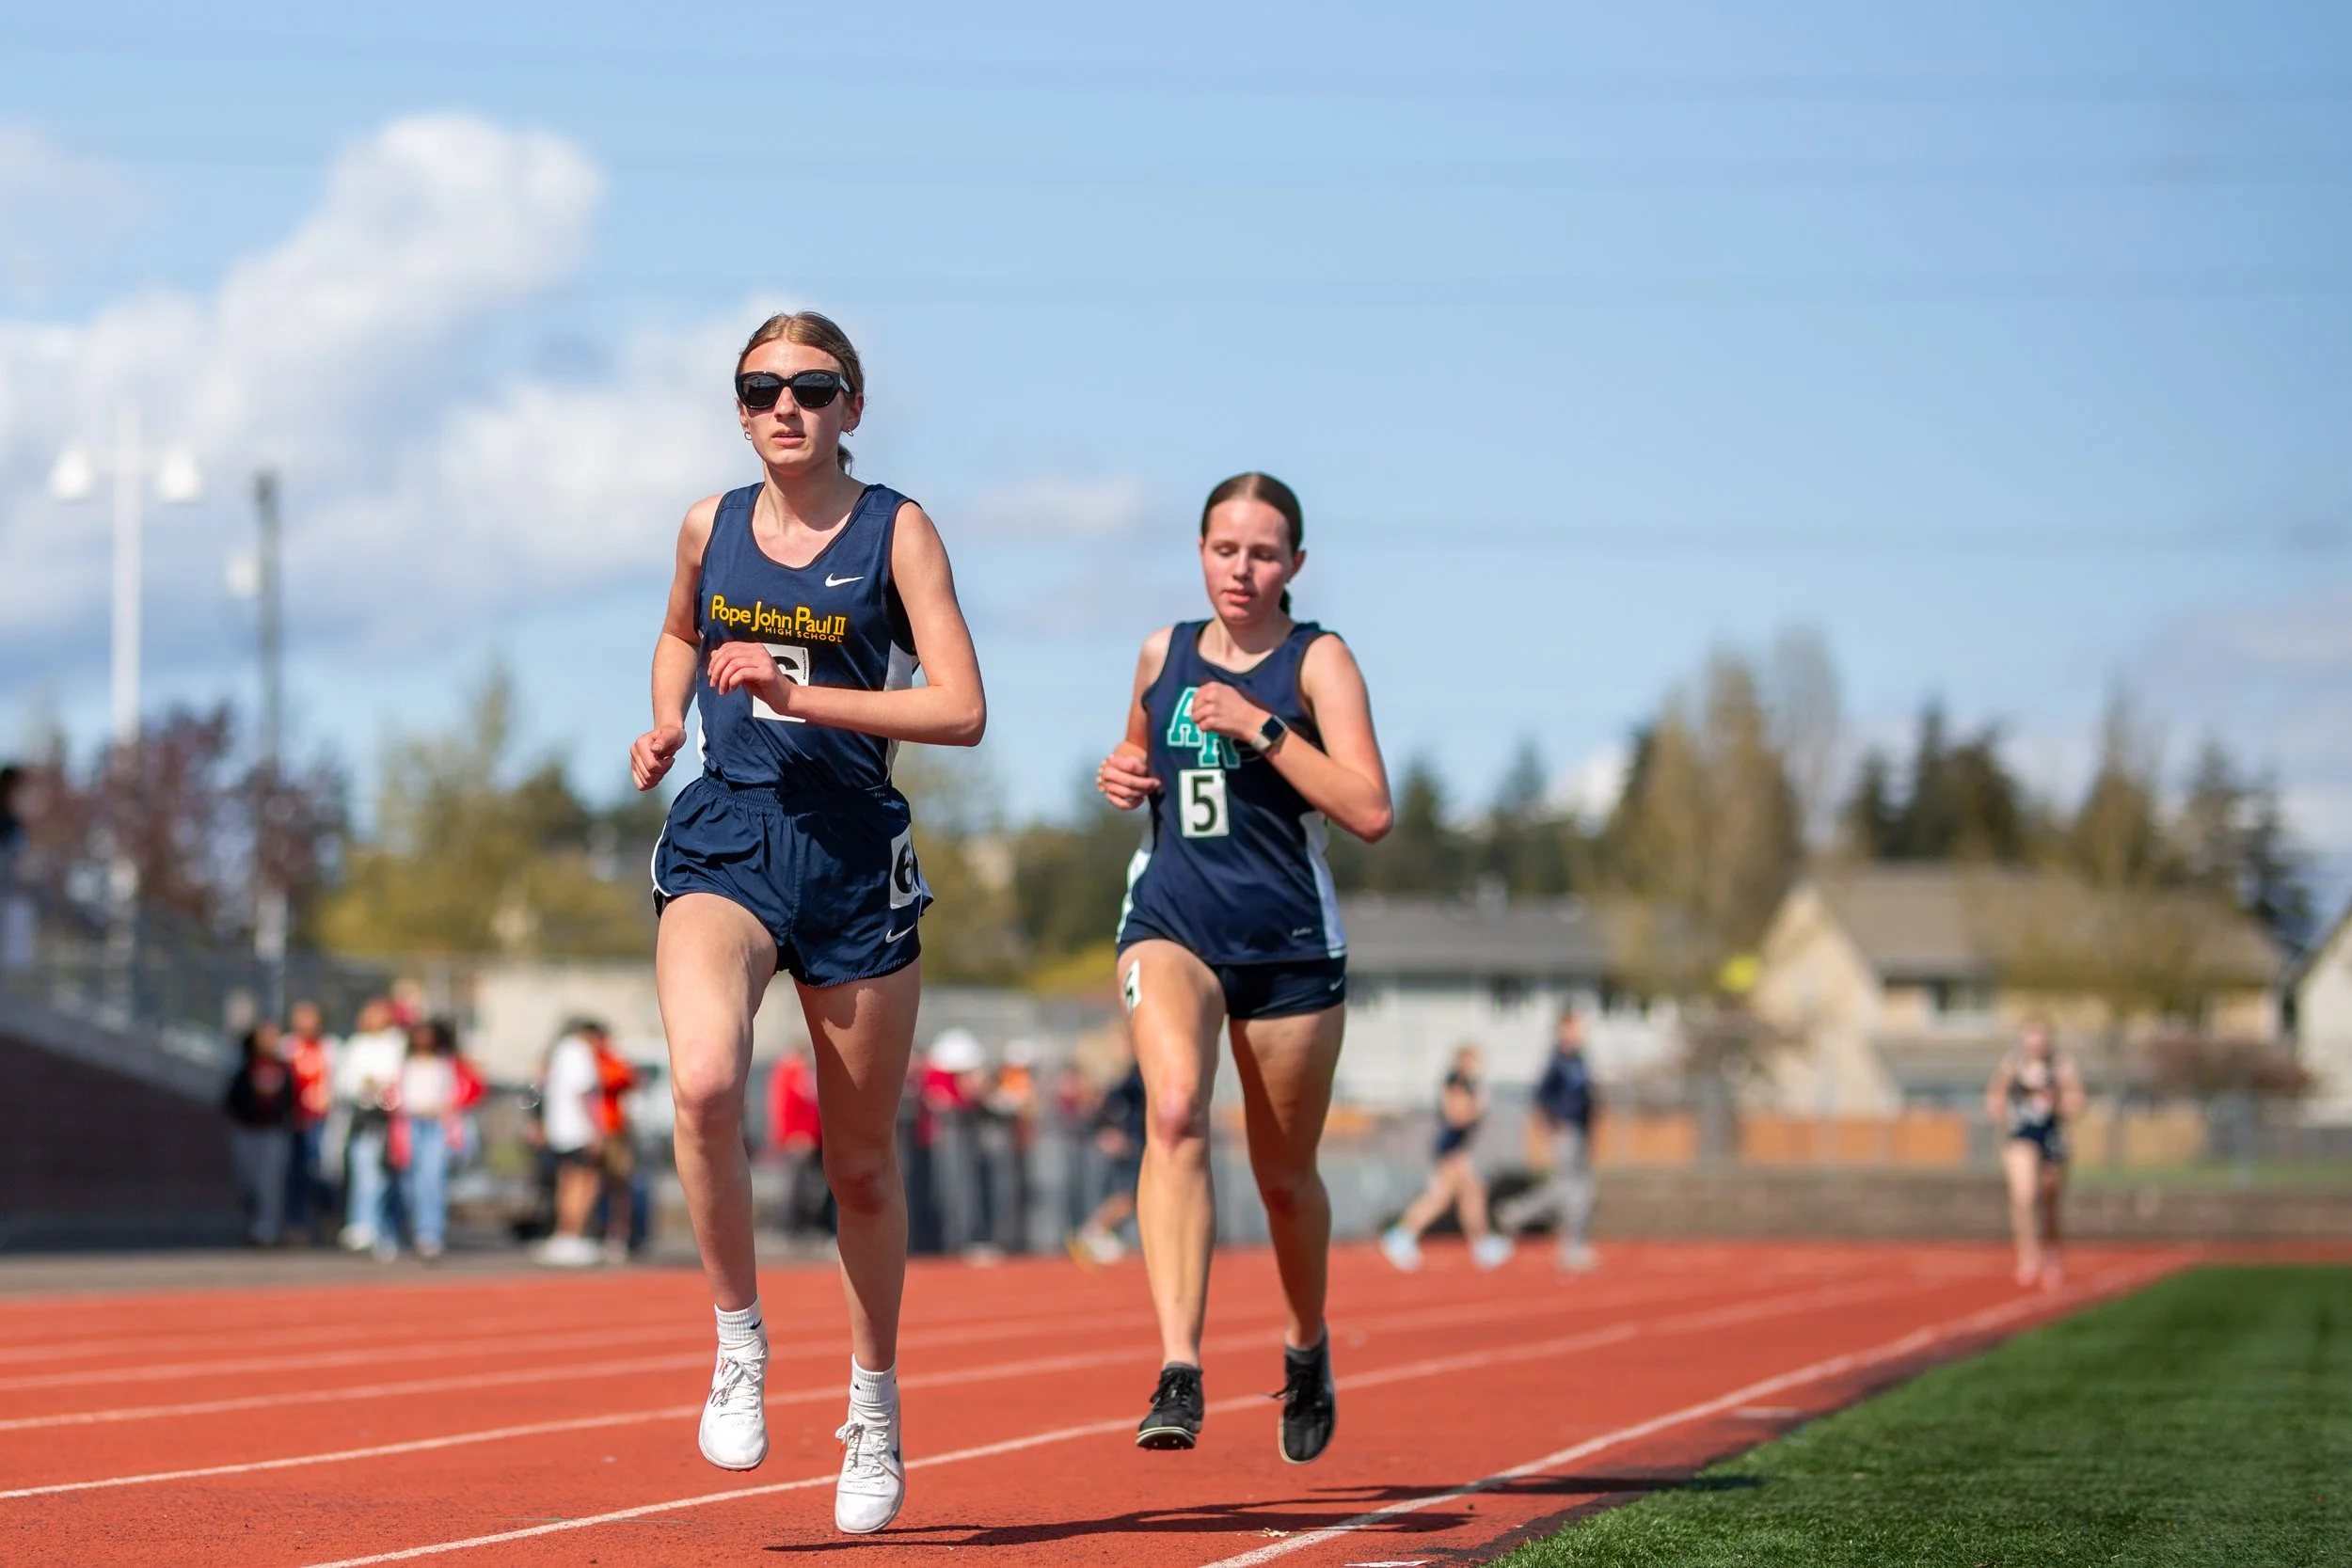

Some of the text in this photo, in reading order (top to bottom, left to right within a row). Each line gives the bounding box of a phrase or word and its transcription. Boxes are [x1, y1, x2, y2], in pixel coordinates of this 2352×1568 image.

[712, 594, 847, 636] Pope John Paul II
[765, 626, 842, 642] HIGH SCHOOL
[1190, 774, 1218, 832] 5
